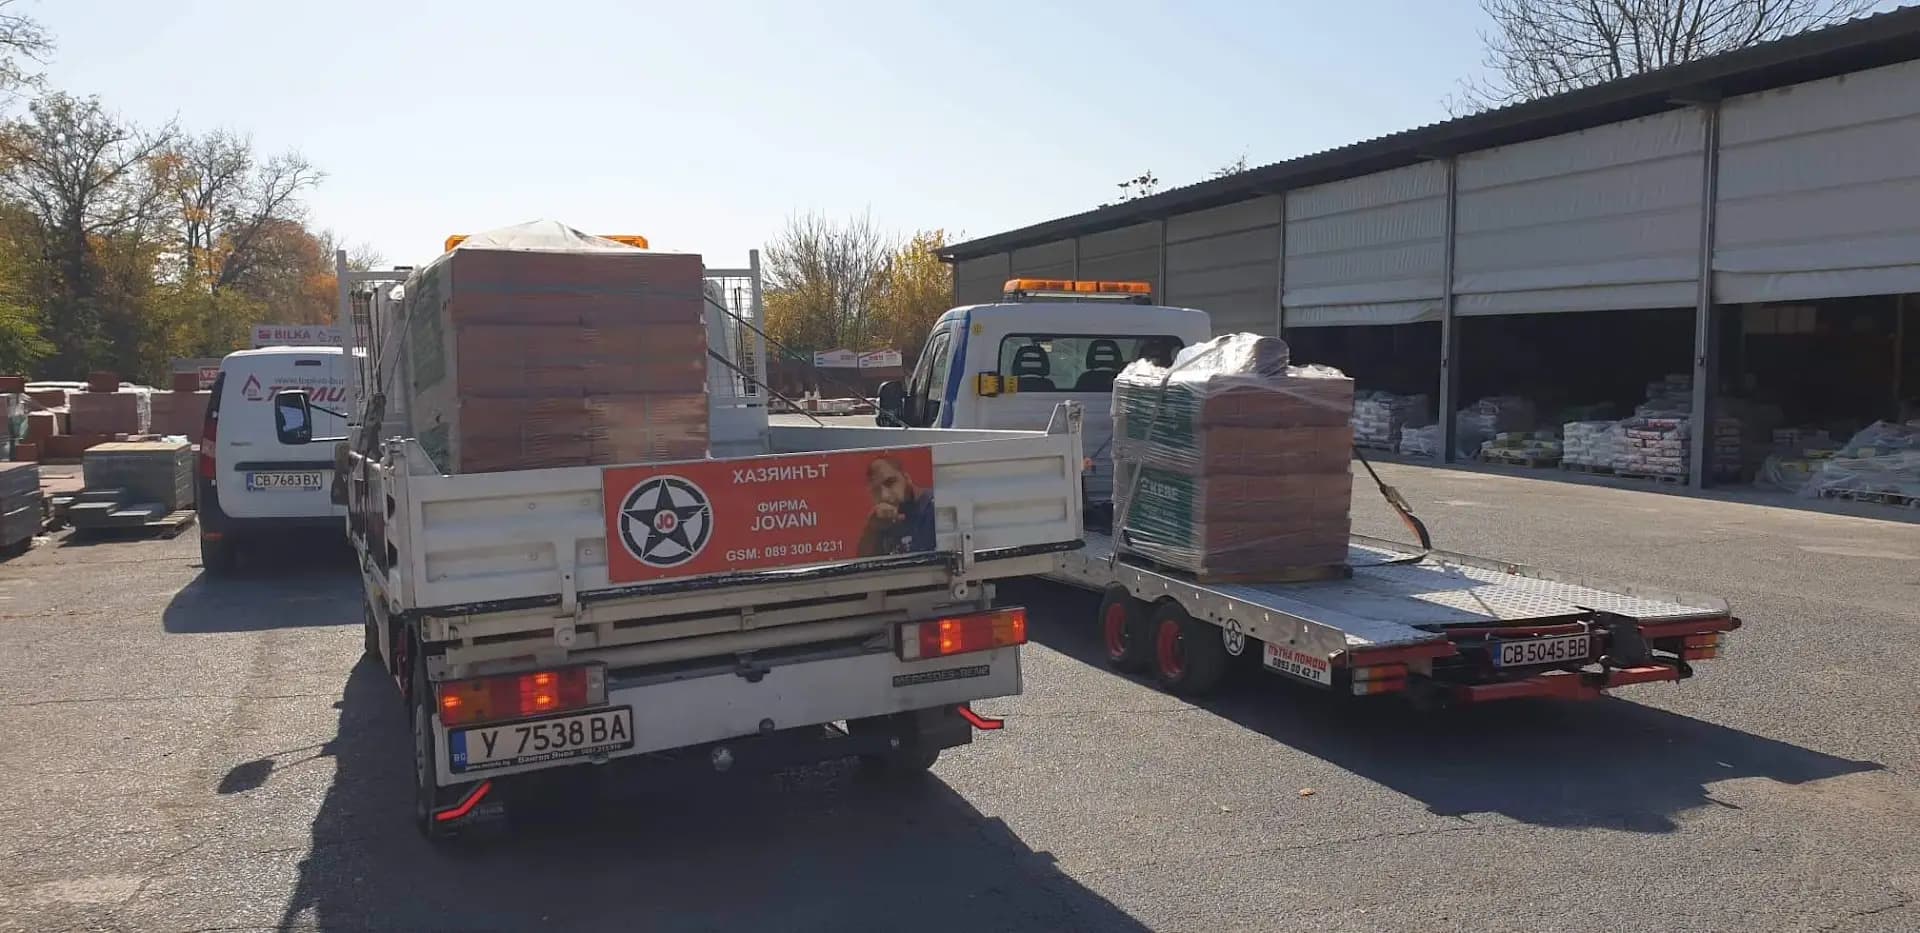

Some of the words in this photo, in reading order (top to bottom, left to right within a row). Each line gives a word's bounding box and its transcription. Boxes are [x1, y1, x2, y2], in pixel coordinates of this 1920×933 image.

[274, 329, 311, 340] BILKA
[255, 475, 271, 487] CB
[273, 474, 302, 486] 7683
[303, 474, 319, 486] BX
[733, 464, 829, 484] ХАЗЯИНЪТ
[757, 499, 808, 512] ФИРМА
[656, 513, 675, 530] JO
[751, 512, 817, 531] JOVANI
[726, 548, 761, 562] GSM:
[765, 545, 787, 558] 089
[790, 542, 813, 555] 300
[815, 540, 844, 553] 4231
[1503, 644, 1523, 664] CB
[1527, 641, 1565, 662] 5045
[1568, 638, 1587, 657] BB
[515, 720, 585, 753] 7538
[589, 714, 627, 743] BA
